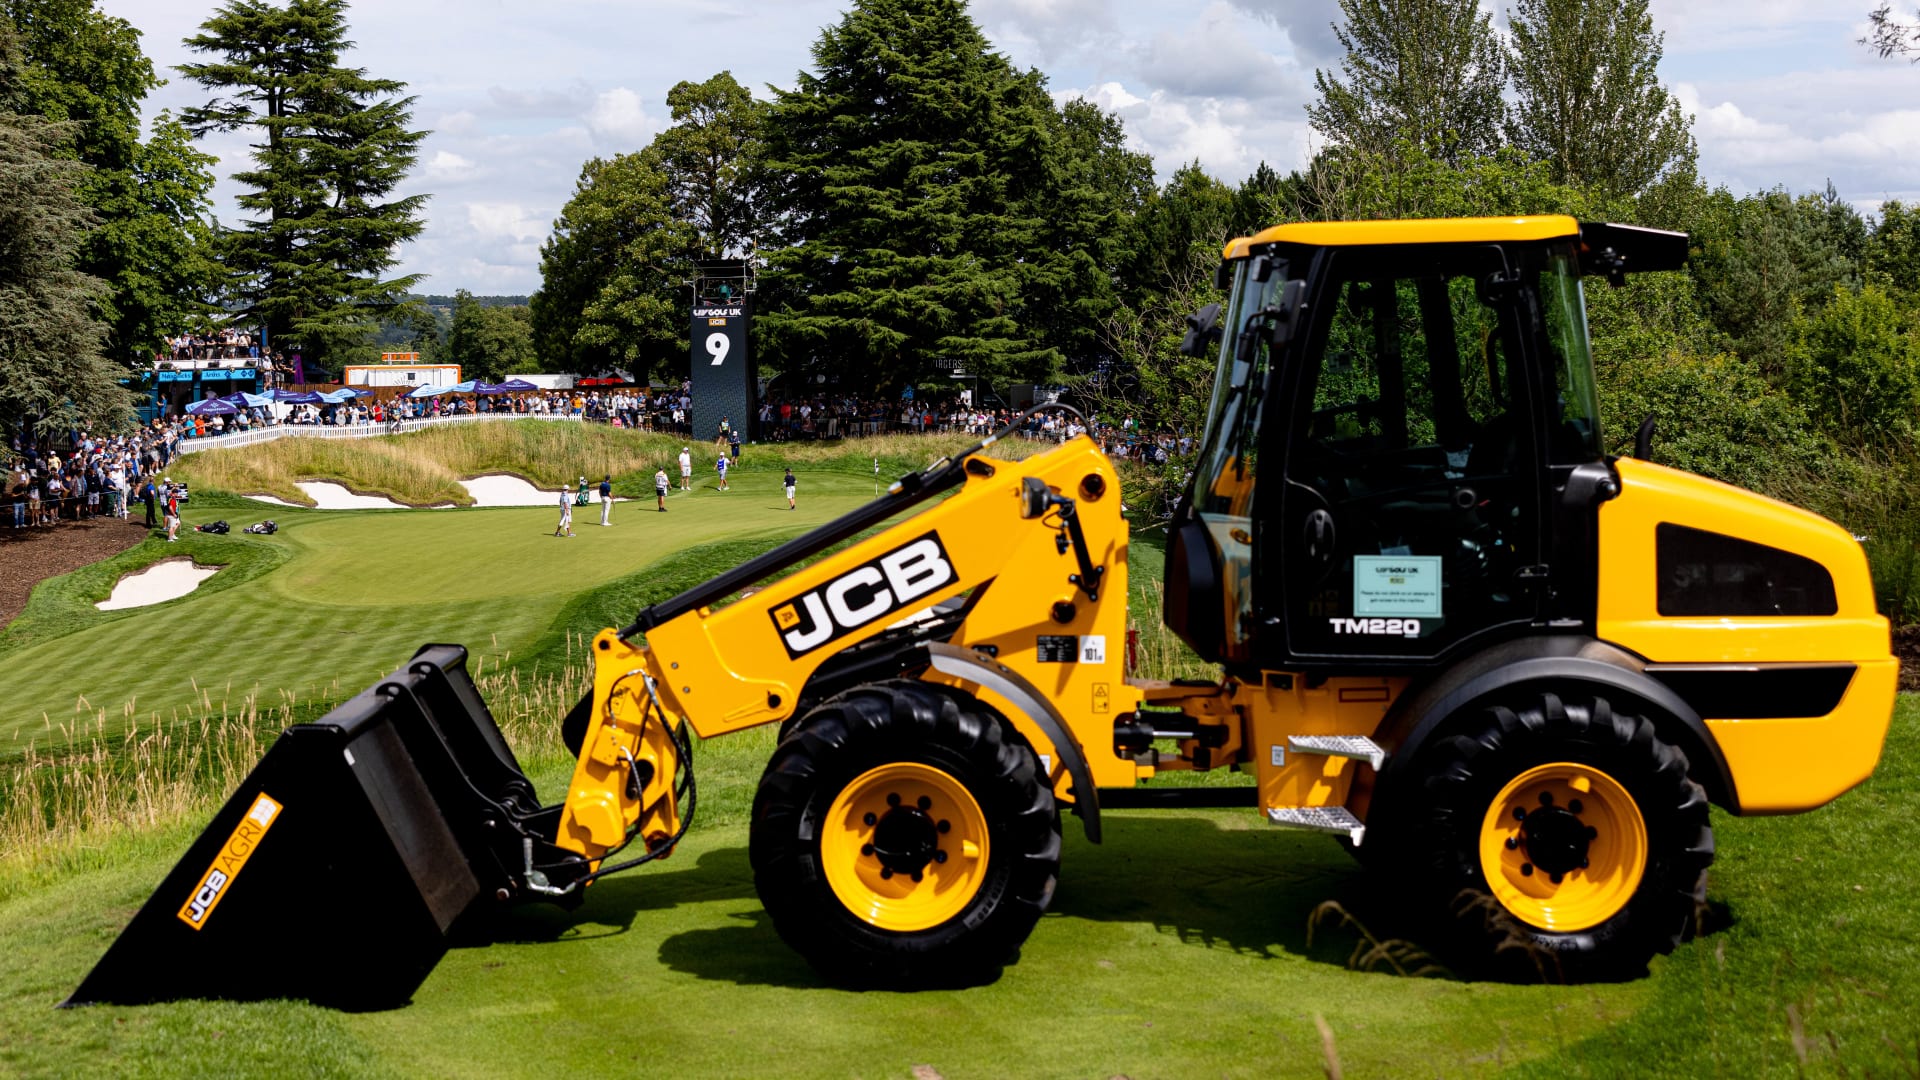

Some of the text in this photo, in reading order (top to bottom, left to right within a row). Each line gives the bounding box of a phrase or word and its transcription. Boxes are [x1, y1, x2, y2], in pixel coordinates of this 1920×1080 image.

[729, 308, 741, 316] UK
[705, 332, 730, 366] 9
[784, 538, 953, 653] JCB
[1329, 618, 1421, 635] TM220
[190, 819, 263, 922] JCB AGRI
